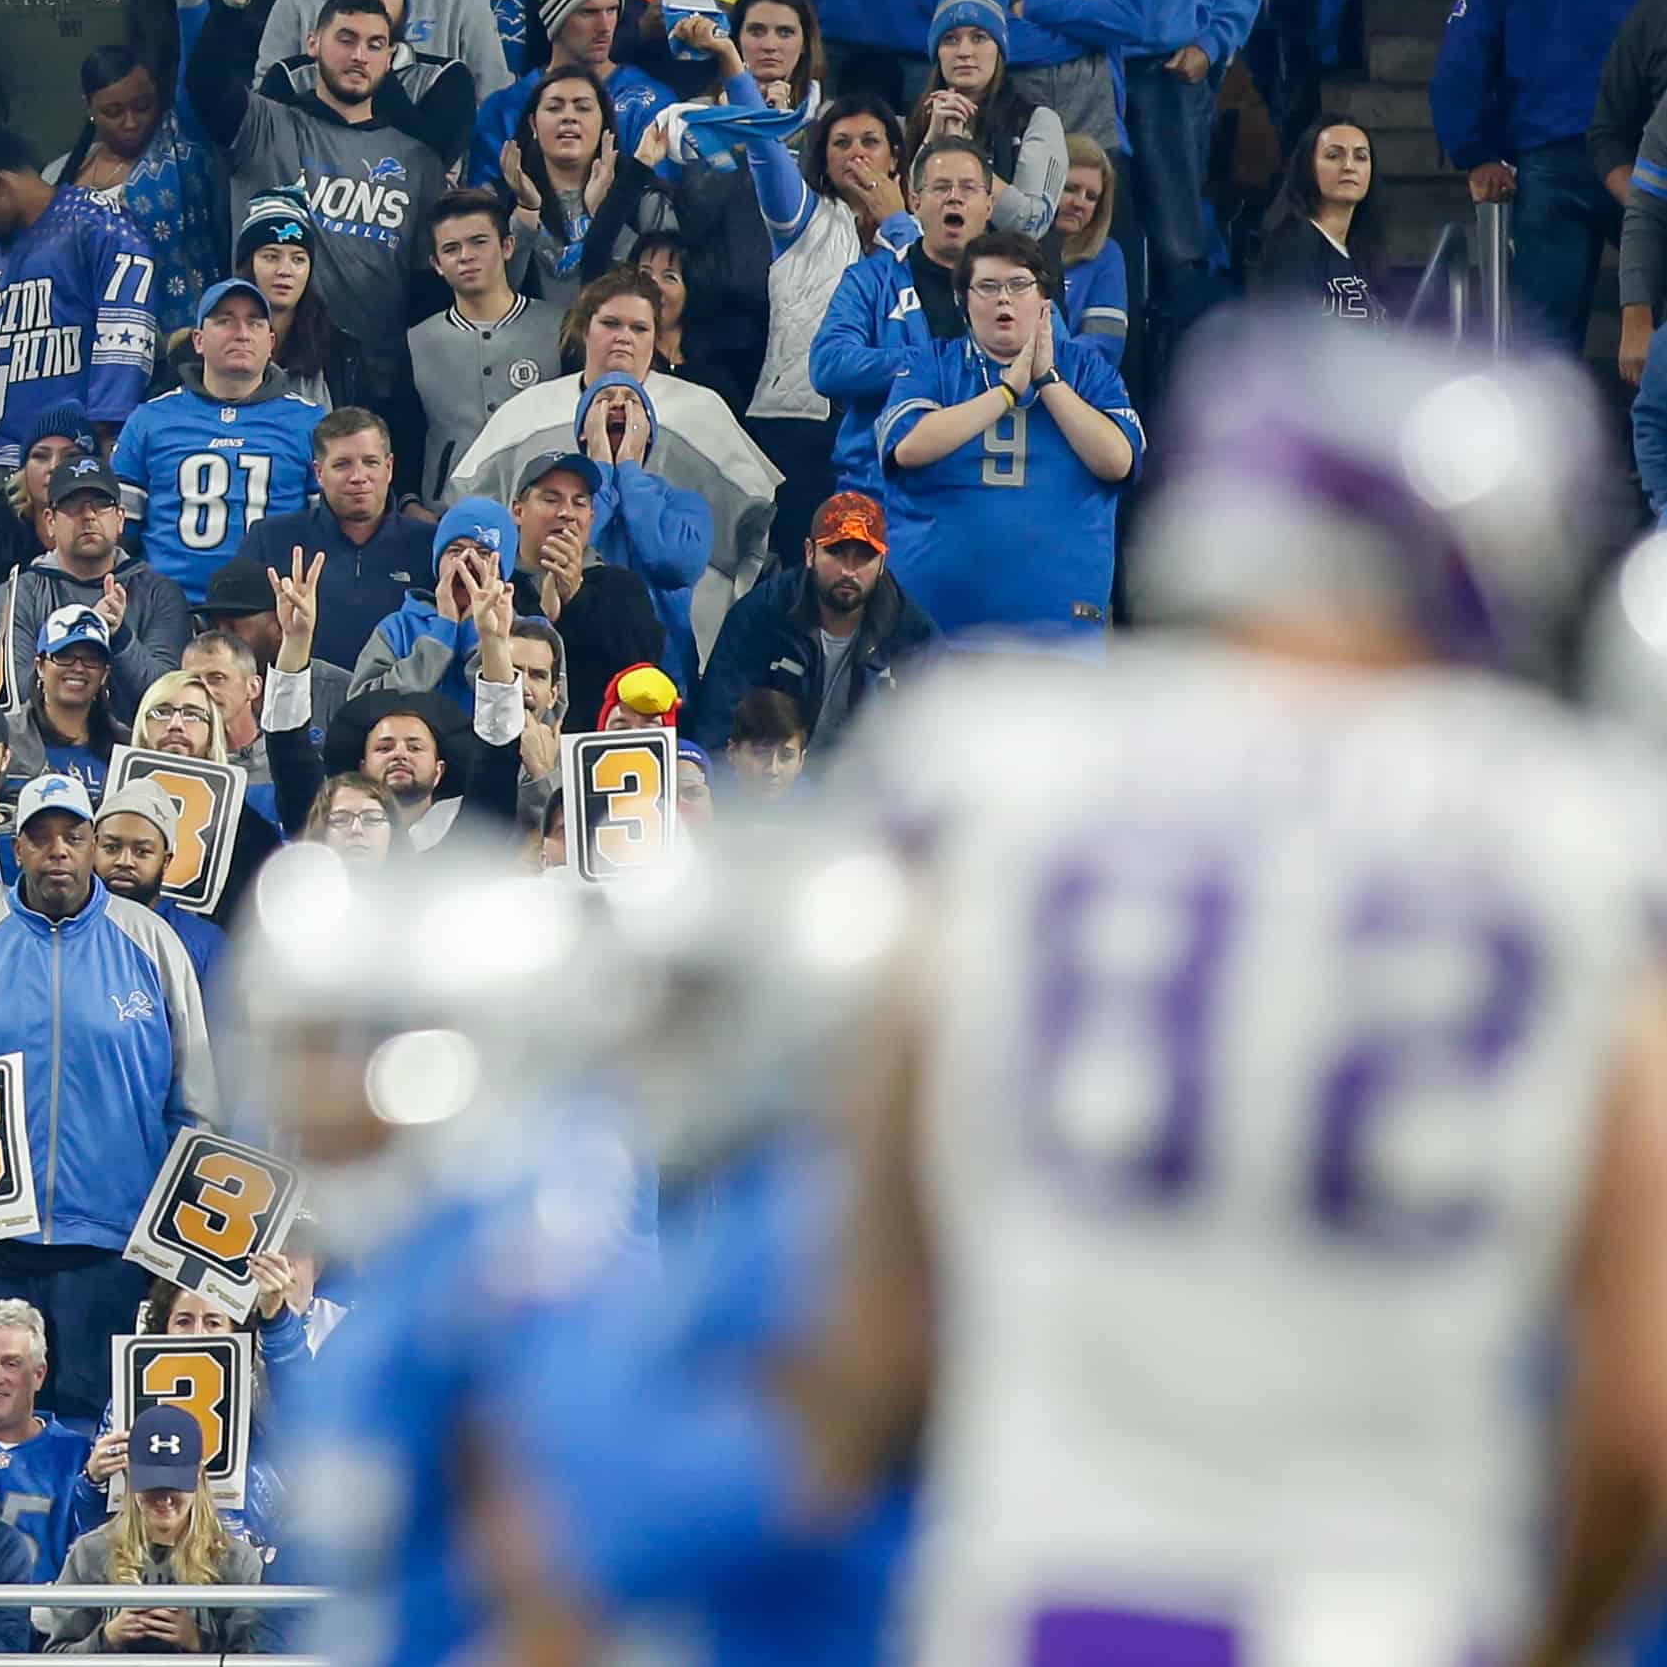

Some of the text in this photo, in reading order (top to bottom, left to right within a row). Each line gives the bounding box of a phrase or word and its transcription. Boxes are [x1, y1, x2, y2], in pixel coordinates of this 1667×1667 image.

[322, 218, 390, 243] TBALL
[103, 252, 155, 304] 77
[207, 436, 246, 449] LIONS
[980, 403, 1027, 487] 9
[176, 451, 273, 550] 81
[1018, 833, 1553, 1268] 82
[174, 1155, 269, 1260] 3
